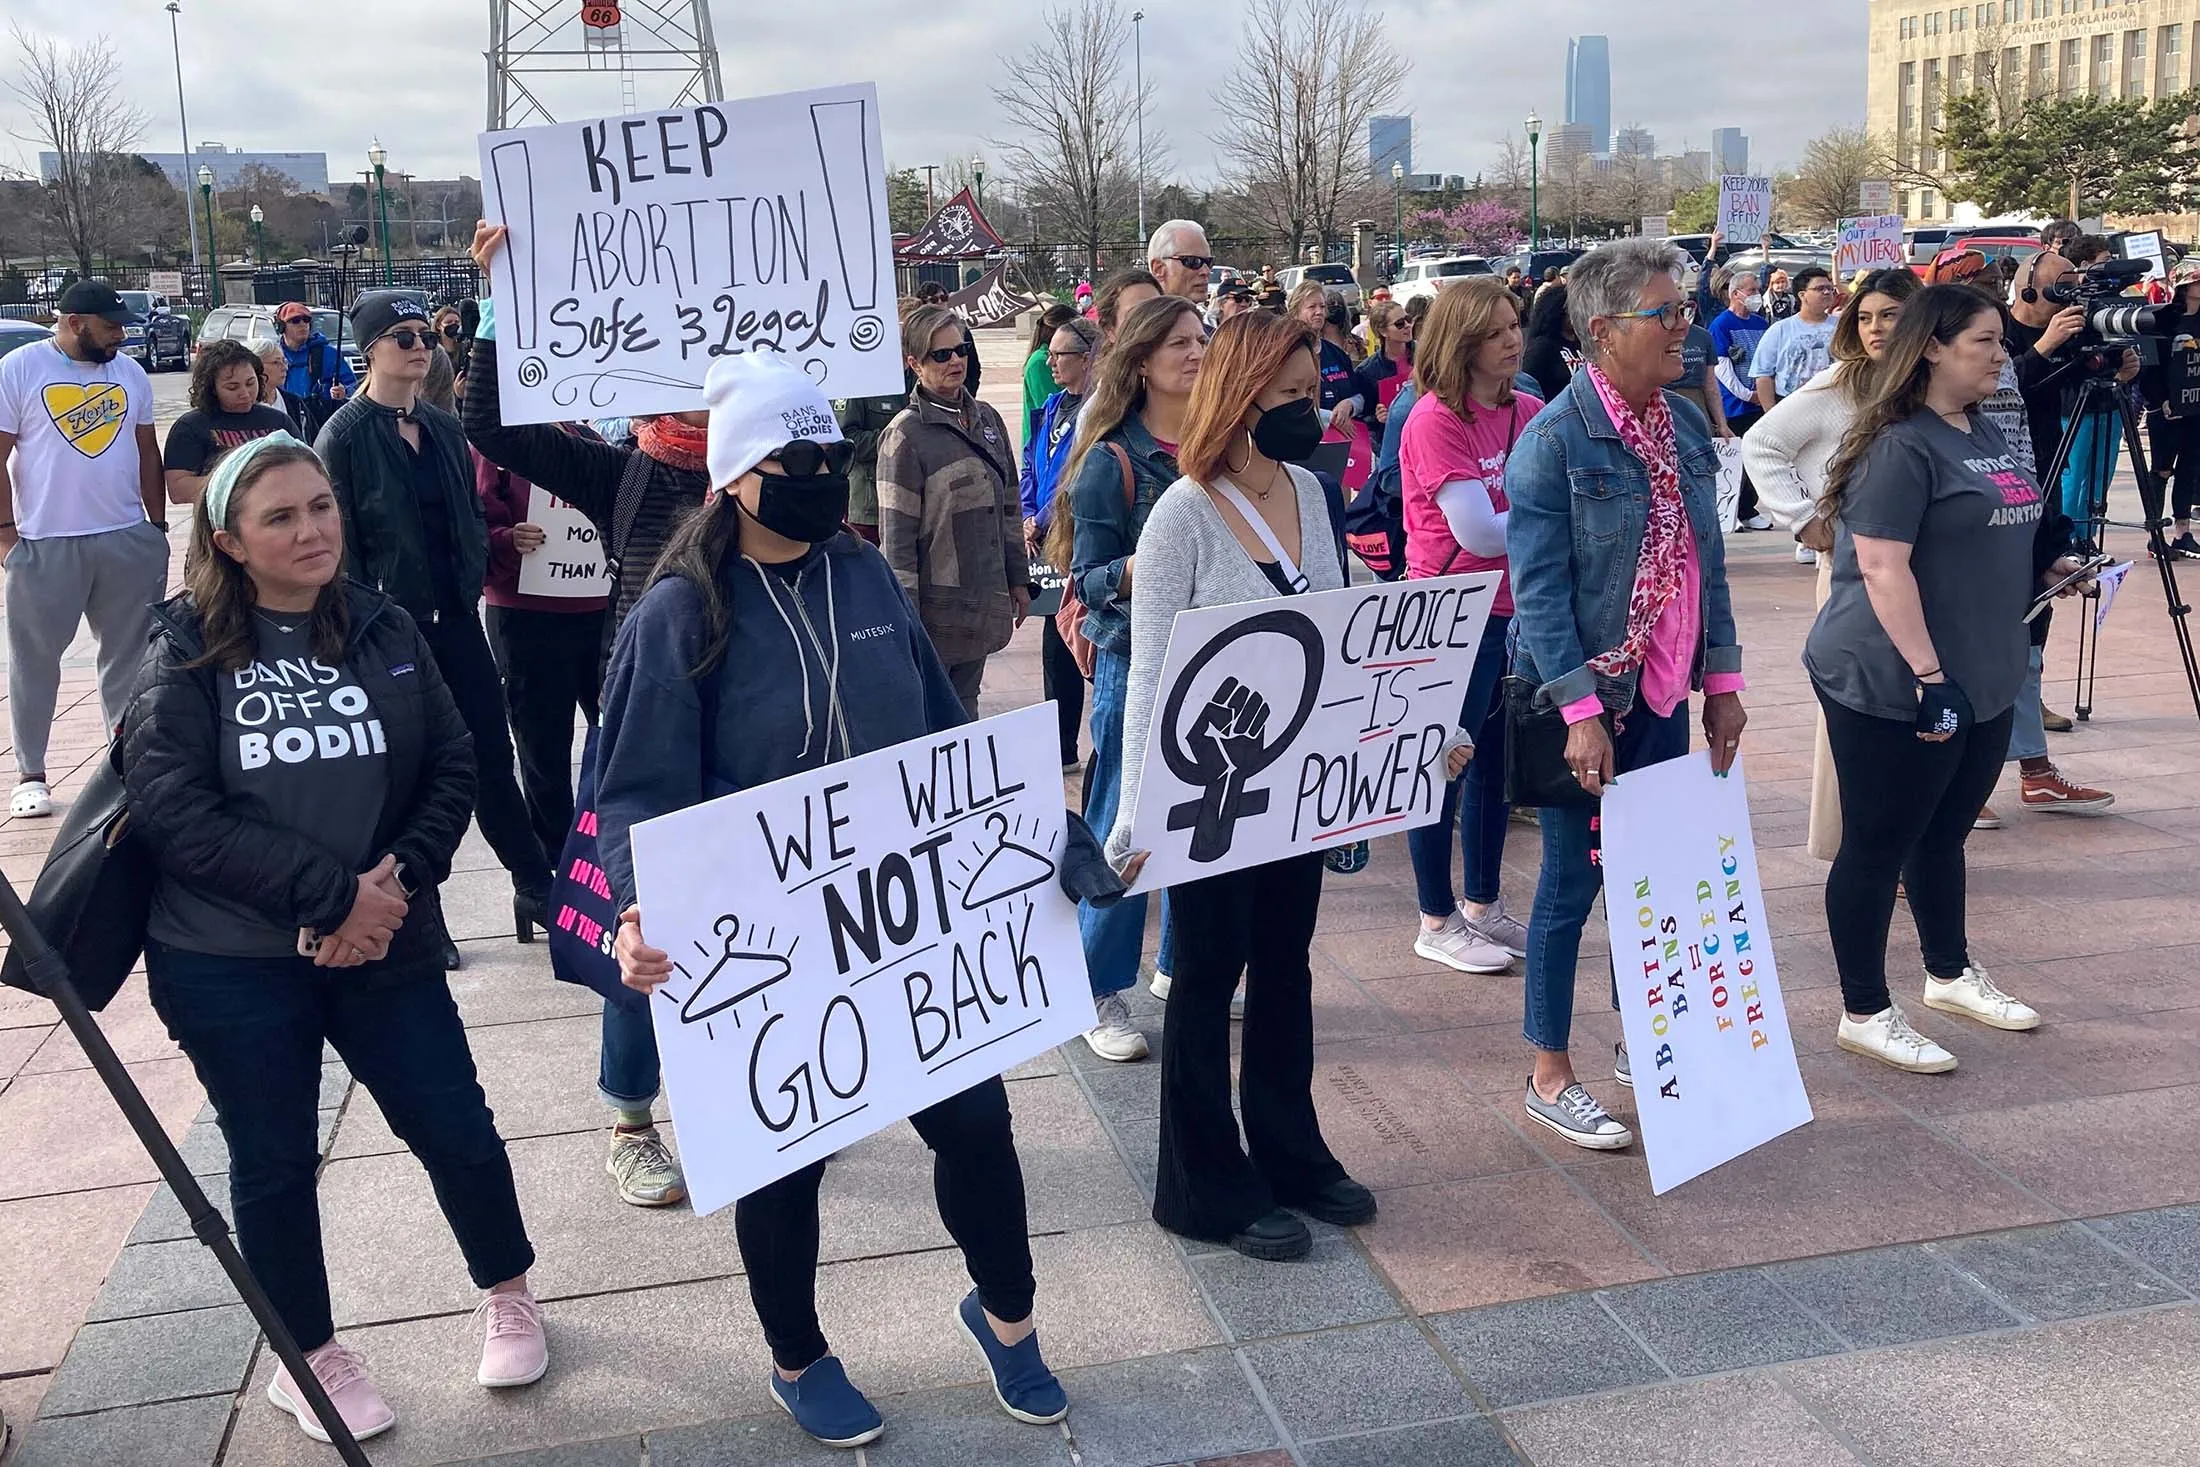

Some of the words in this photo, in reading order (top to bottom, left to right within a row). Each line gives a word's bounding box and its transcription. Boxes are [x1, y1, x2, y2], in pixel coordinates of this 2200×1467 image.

[591, 9, 612, 23] 66
[2012, 23, 2043, 35] STATE
[2050, 20, 2064, 29] OF
[2070, 10, 2137, 26] OKLAHOMA
[582, 105, 728, 205] KEEP
[1723, 176, 1746, 192] KEEP
[1747, 177, 1769, 193] YOUR
[1726, 211, 1744, 222] OFF
[1745, 211, 1760, 223] MY
[1731, 193, 1759, 212] BAN
[571, 190, 809, 298] ABORTION
[1727, 223, 1767, 243] BODY
[1846, 229, 1866, 241] OUT
[1840, 243, 1863, 268] MY
[1863, 239, 1903, 263] UTERUS
[549, 296, 661, 363] Safe
[707, 279, 836, 357] Legal
[781, 405, 818, 422] BANS
[786, 416, 812, 430] OFF
[813, 414, 833, 425] OUR
[791, 425, 832, 439] BODIES
[1363, 543, 1386, 553] LOVE
[548, 562, 596, 579] THAN
[1040, 577, 1068, 589] Care
[850, 624, 895, 641] MUTESIX
[1341, 584, 1486, 664] CHOICE
[234, 656, 340, 689] BANS
[235, 690, 322, 726] OFF
[1942, 708, 1951, 730] OUR
[1291, 723, 1446, 842] POWER
[757, 782, 856, 883] WE
[898, 734, 1026, 828] WILL
[568, 857, 592, 885] IN
[822, 832, 953, 975] NOT
[556, 904, 578, 932] IN
[575, 913, 603, 949] THE
[1696, 879, 1734, 1033] FORCED
[1718, 834, 1769, 1051] PREGNANCY
[1660, 915, 1689, 1019] BANS
[1634, 875, 1681, 1100] ABORTION
[748, 994, 869, 1132] GO
[904, 902, 1050, 1062] BACK
[1361, 1098, 1400, 1146] FRANCIS
